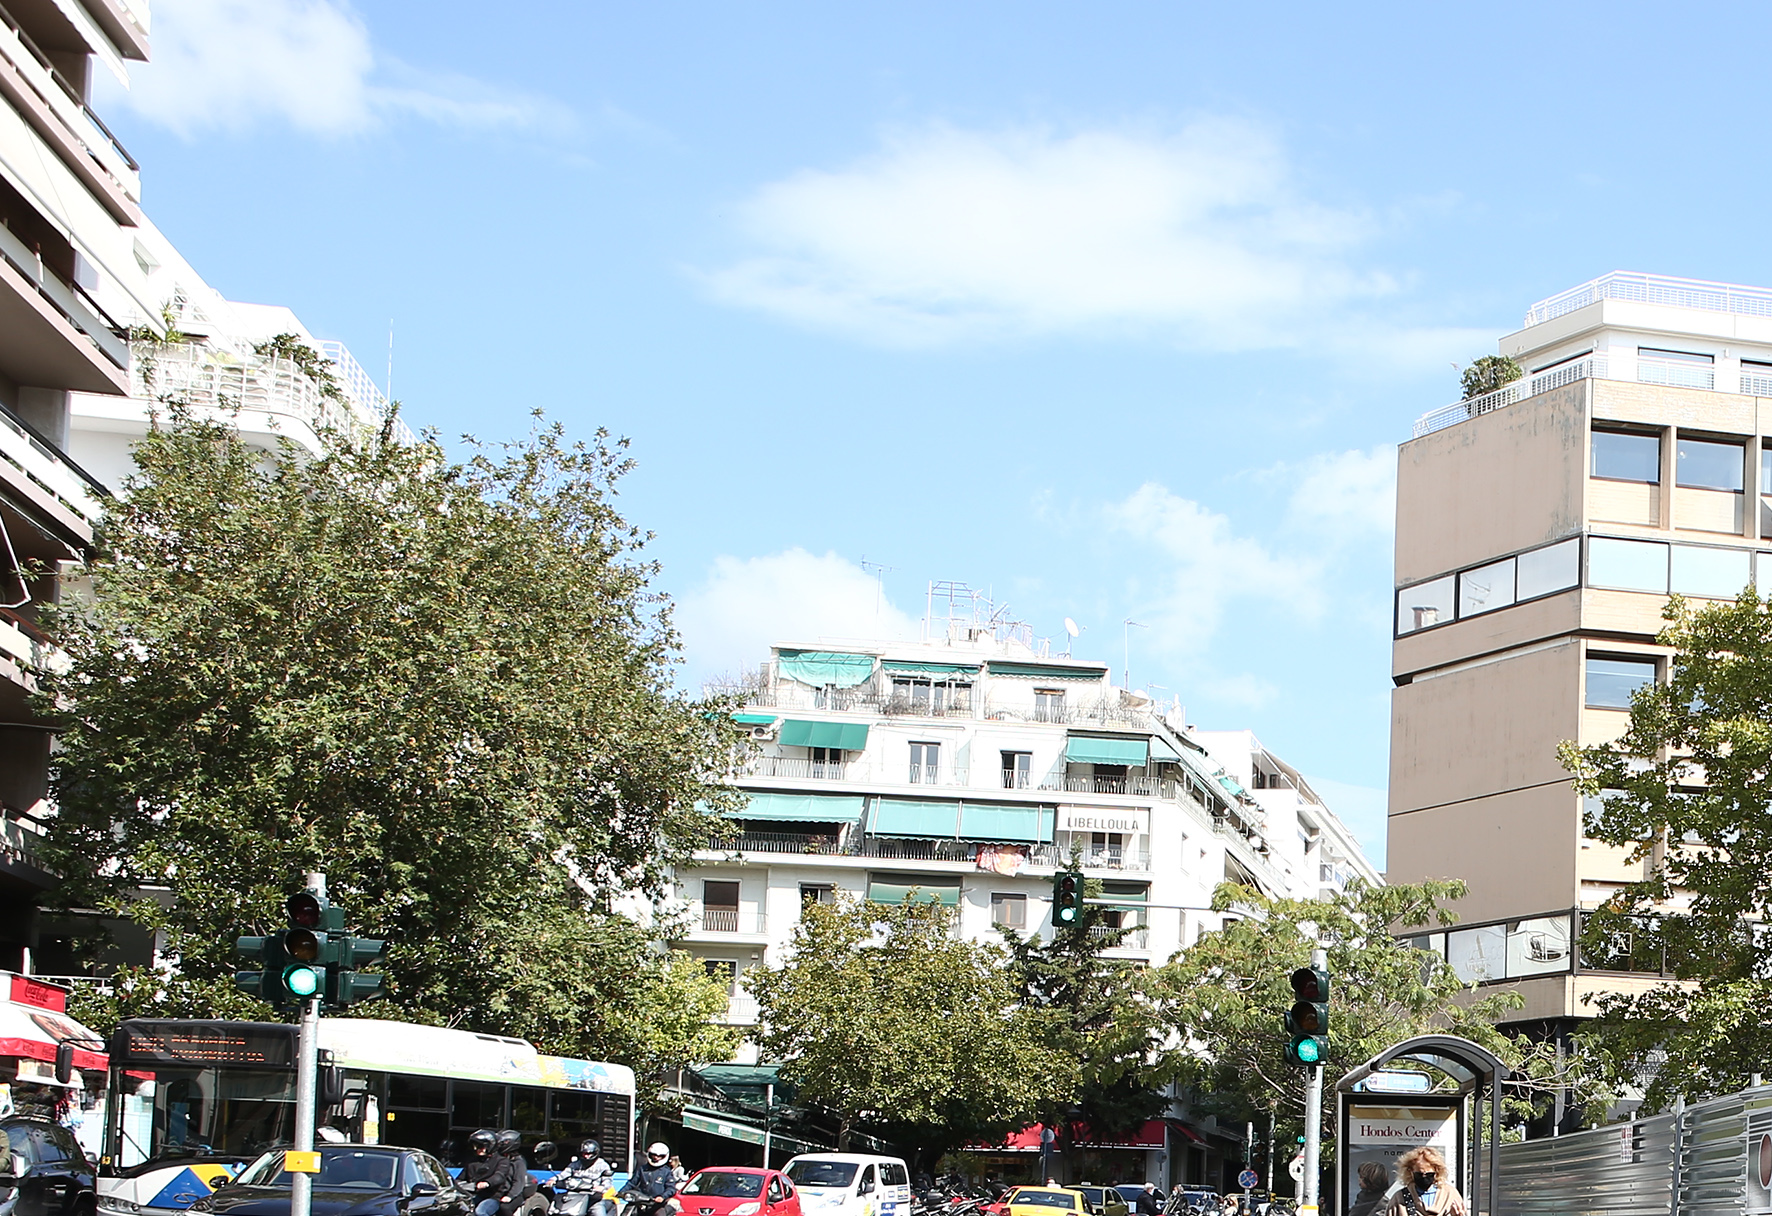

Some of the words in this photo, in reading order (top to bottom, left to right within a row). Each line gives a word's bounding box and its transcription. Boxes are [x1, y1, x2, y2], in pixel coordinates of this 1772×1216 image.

[1067, 817, 1139, 831] LIBELLOULA
[1360, 1124, 1403, 1138] Hondos
[1404, 1125, 1442, 1138] Center
